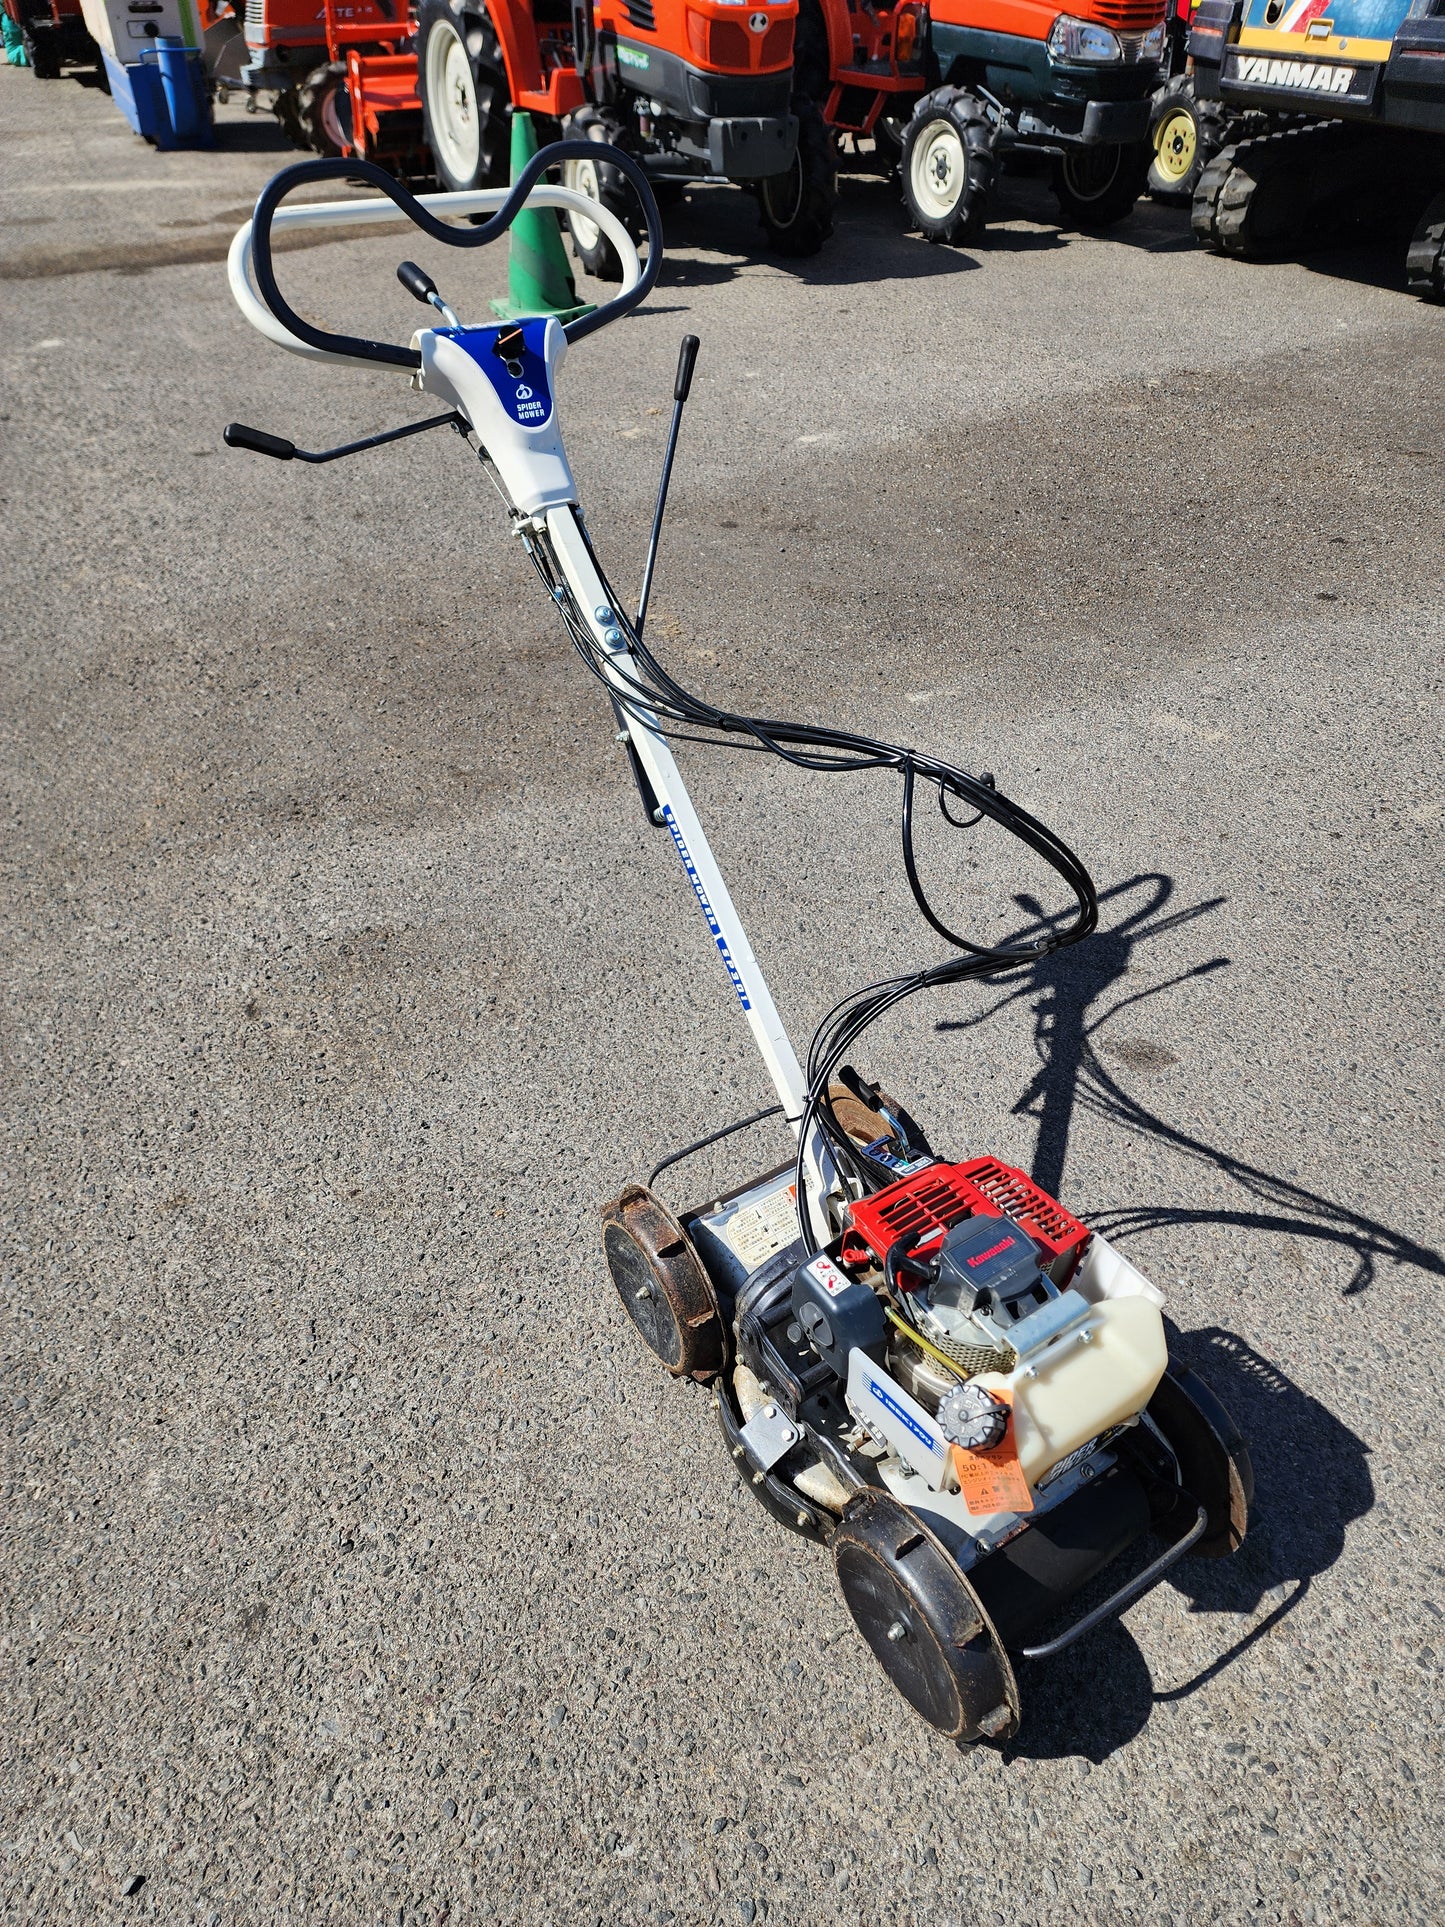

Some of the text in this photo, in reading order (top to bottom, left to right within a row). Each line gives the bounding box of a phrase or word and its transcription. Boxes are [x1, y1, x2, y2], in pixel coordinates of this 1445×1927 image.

[1237, 55, 1354, 94] YANMAR
[516, 401, 542, 412] SPIDER
[518, 408, 545, 420] MOWER
[666, 813, 748, 1001] SPIDER MOWER SP301
[966, 1235, 1017, 1268] Kawasaki
[1050, 1437, 1099, 1475] PIDER
